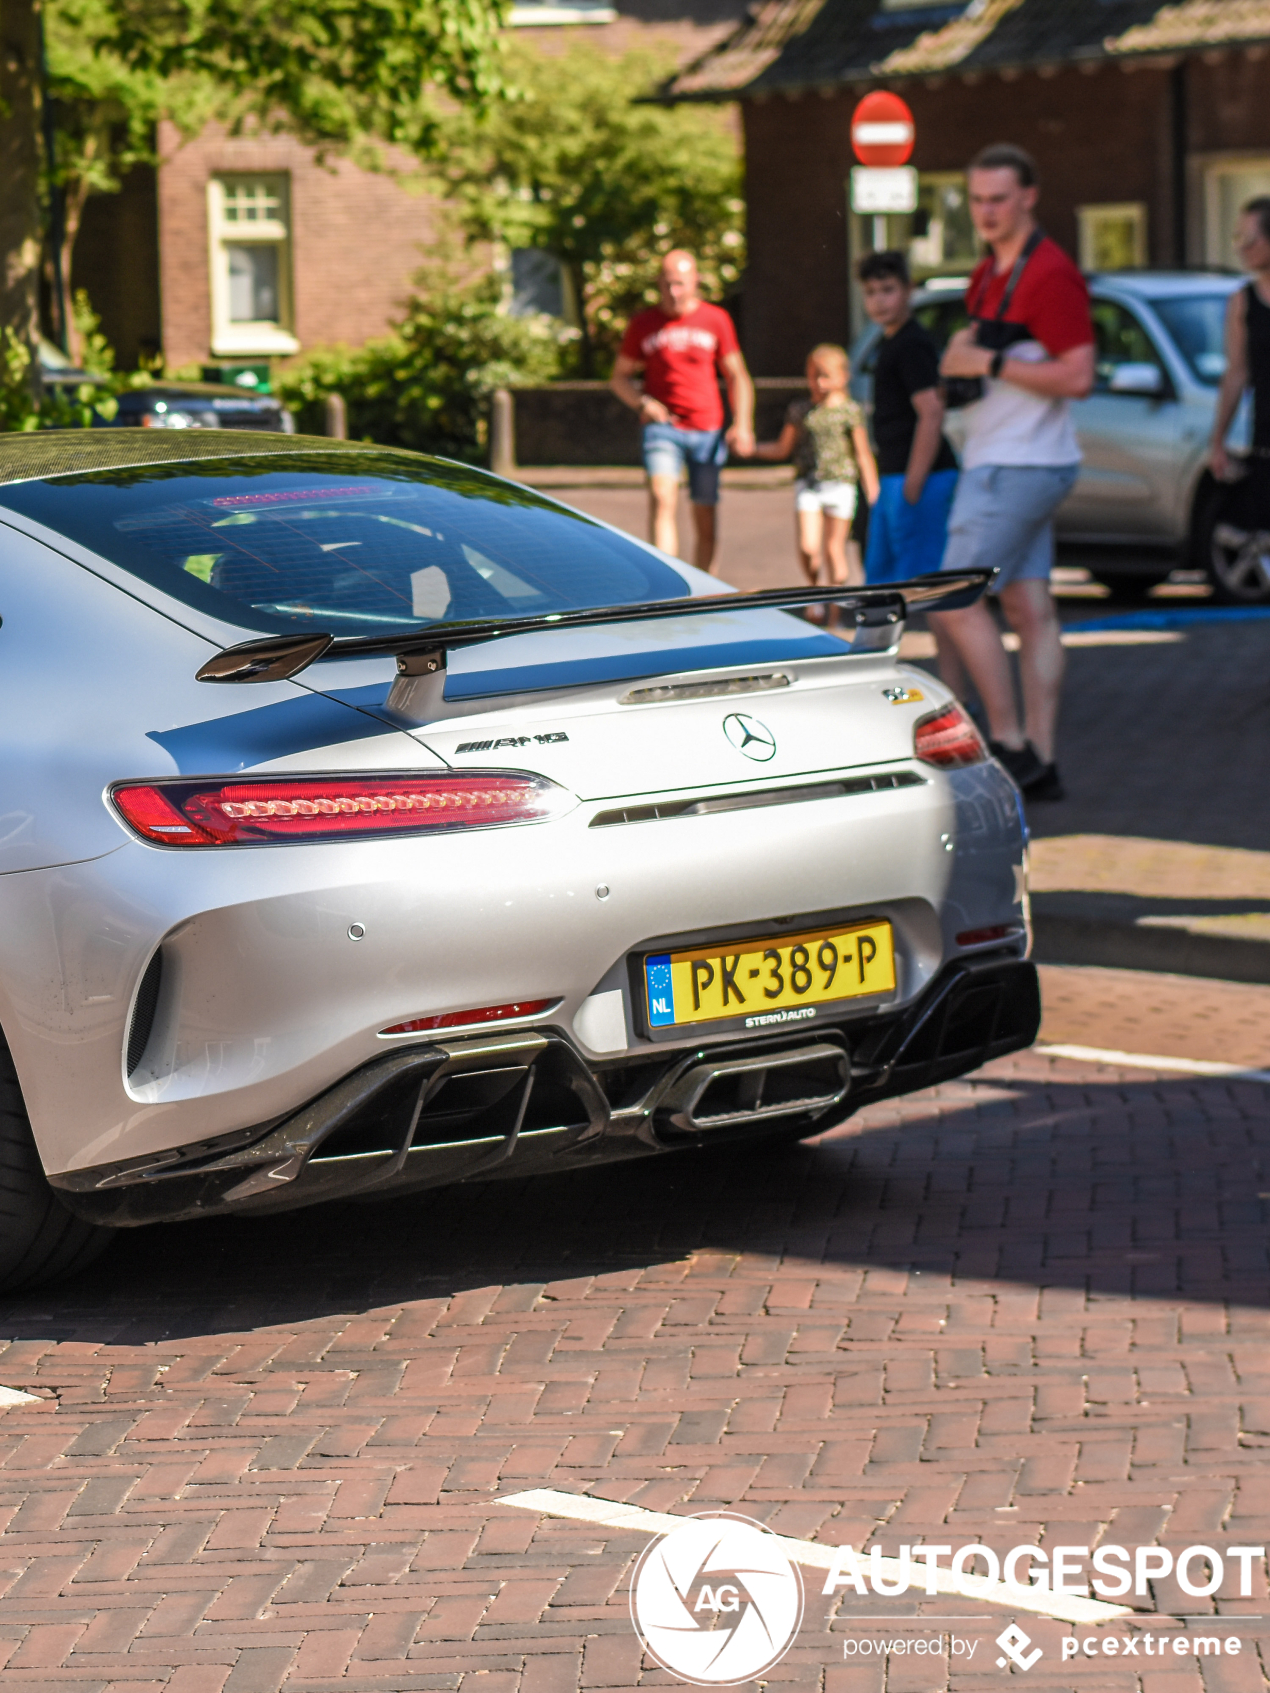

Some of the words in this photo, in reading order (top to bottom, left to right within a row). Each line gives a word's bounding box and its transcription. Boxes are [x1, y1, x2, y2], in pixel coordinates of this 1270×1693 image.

[691, 935, 877, 1011] PK-389-P
[652, 997, 671, 1015] NL
[745, 1013, 781, 1028] STERN
[788, 1008, 816, 1020] AUTO
